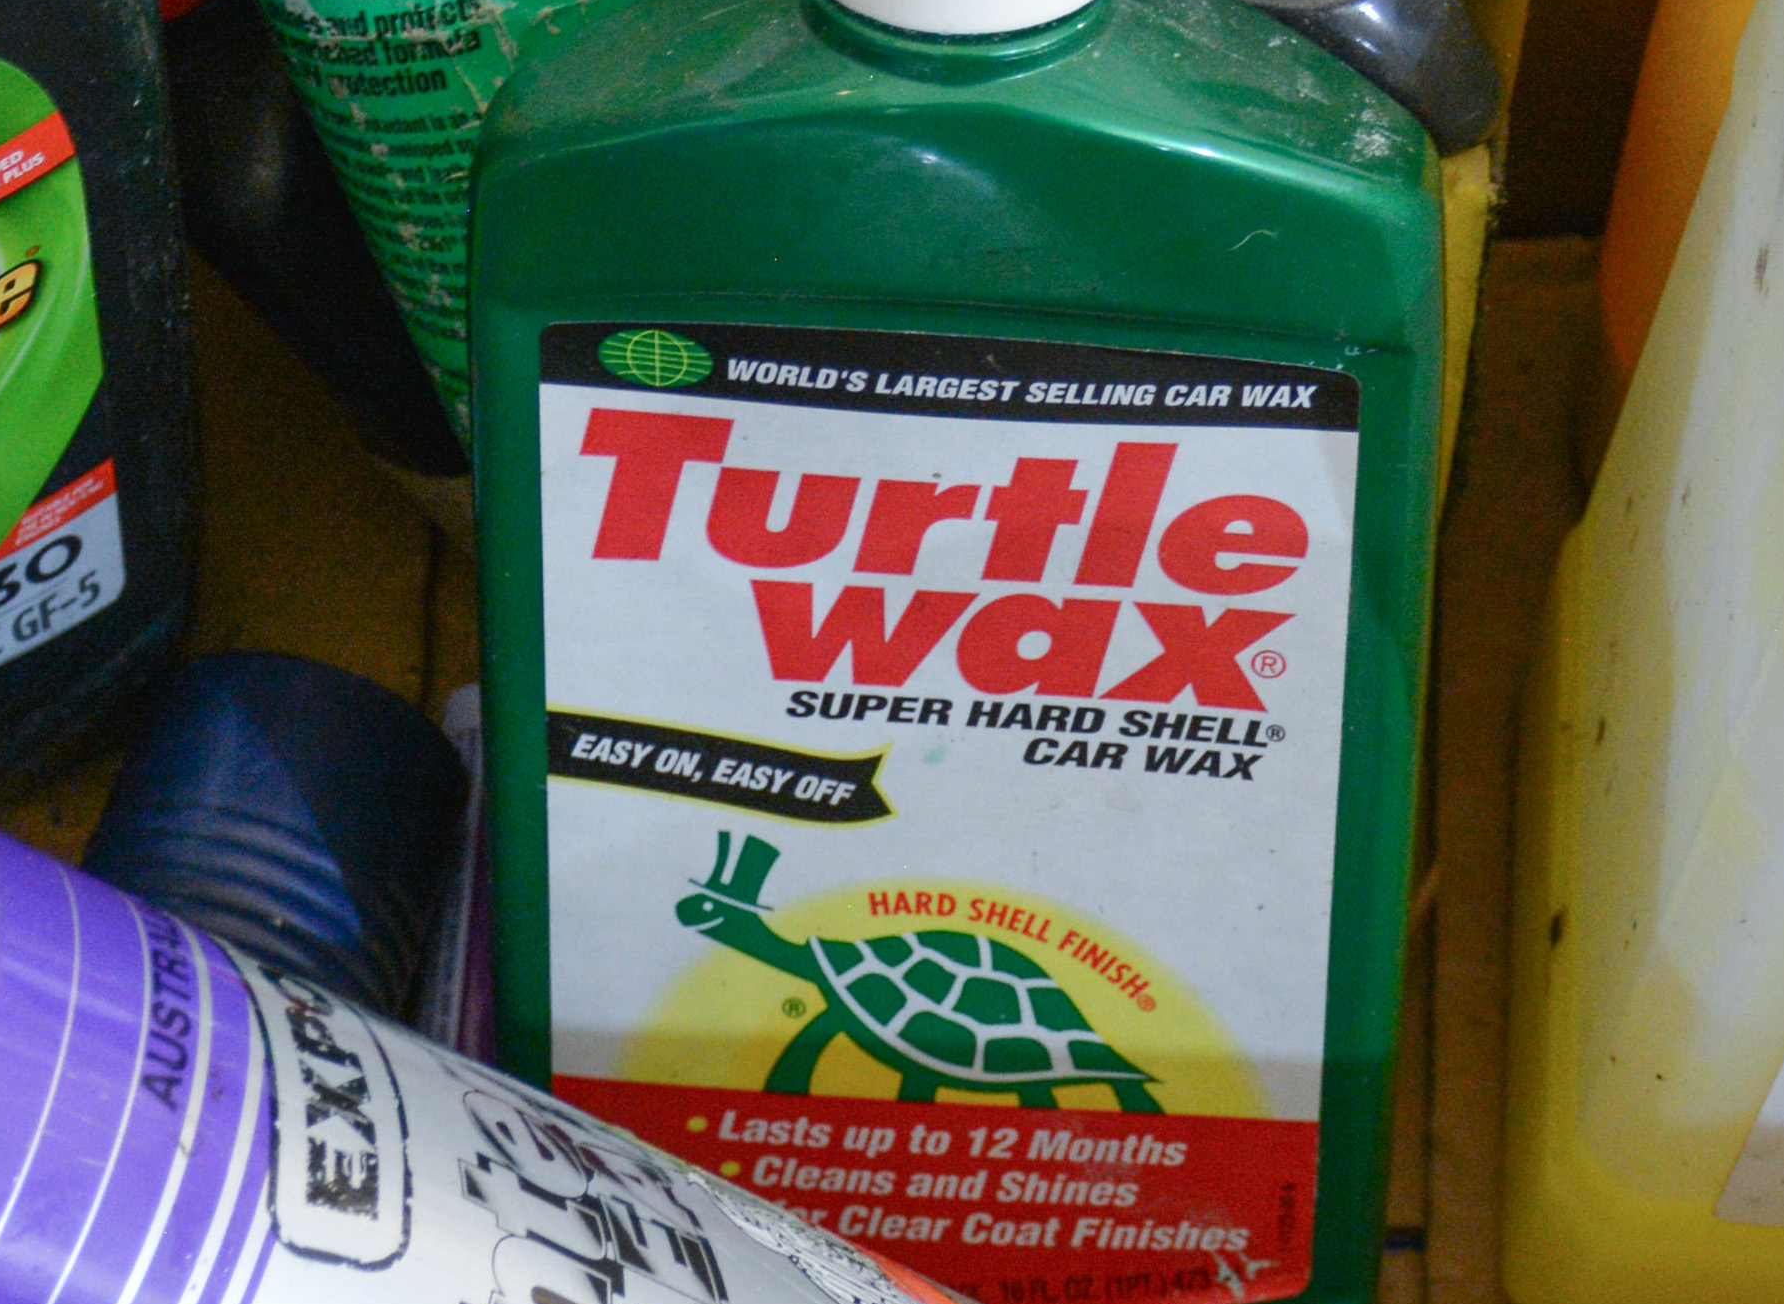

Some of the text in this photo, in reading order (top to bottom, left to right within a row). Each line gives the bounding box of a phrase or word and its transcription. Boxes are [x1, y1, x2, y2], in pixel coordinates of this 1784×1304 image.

[3, 152, 45, 184] PLUS
[726, 357, 1316, 409] WORLD'S LARGEST SELLING CAR WAX
[579, 407, 1309, 596] Turtle
[12, 571, 102, 643] GF-5
[786, 691, 1270, 747] SUPER HARD SHELL
[572, 733, 857, 809] EASY ON, EASY OFF
[1022, 735, 1264, 782] CAR WAX
[868, 890, 957, 917] HARD
[968, 898, 1052, 943] SHELL
[717, 1109, 1189, 1168] Lasts up to 12 Months
[752, 1160, 1139, 1208] Cleans and Shines
[838, 1205, 949, 1244] Clear
[959, 1212, 1061, 1249] Coat
[1070, 1219, 1251, 1256] Finishes
